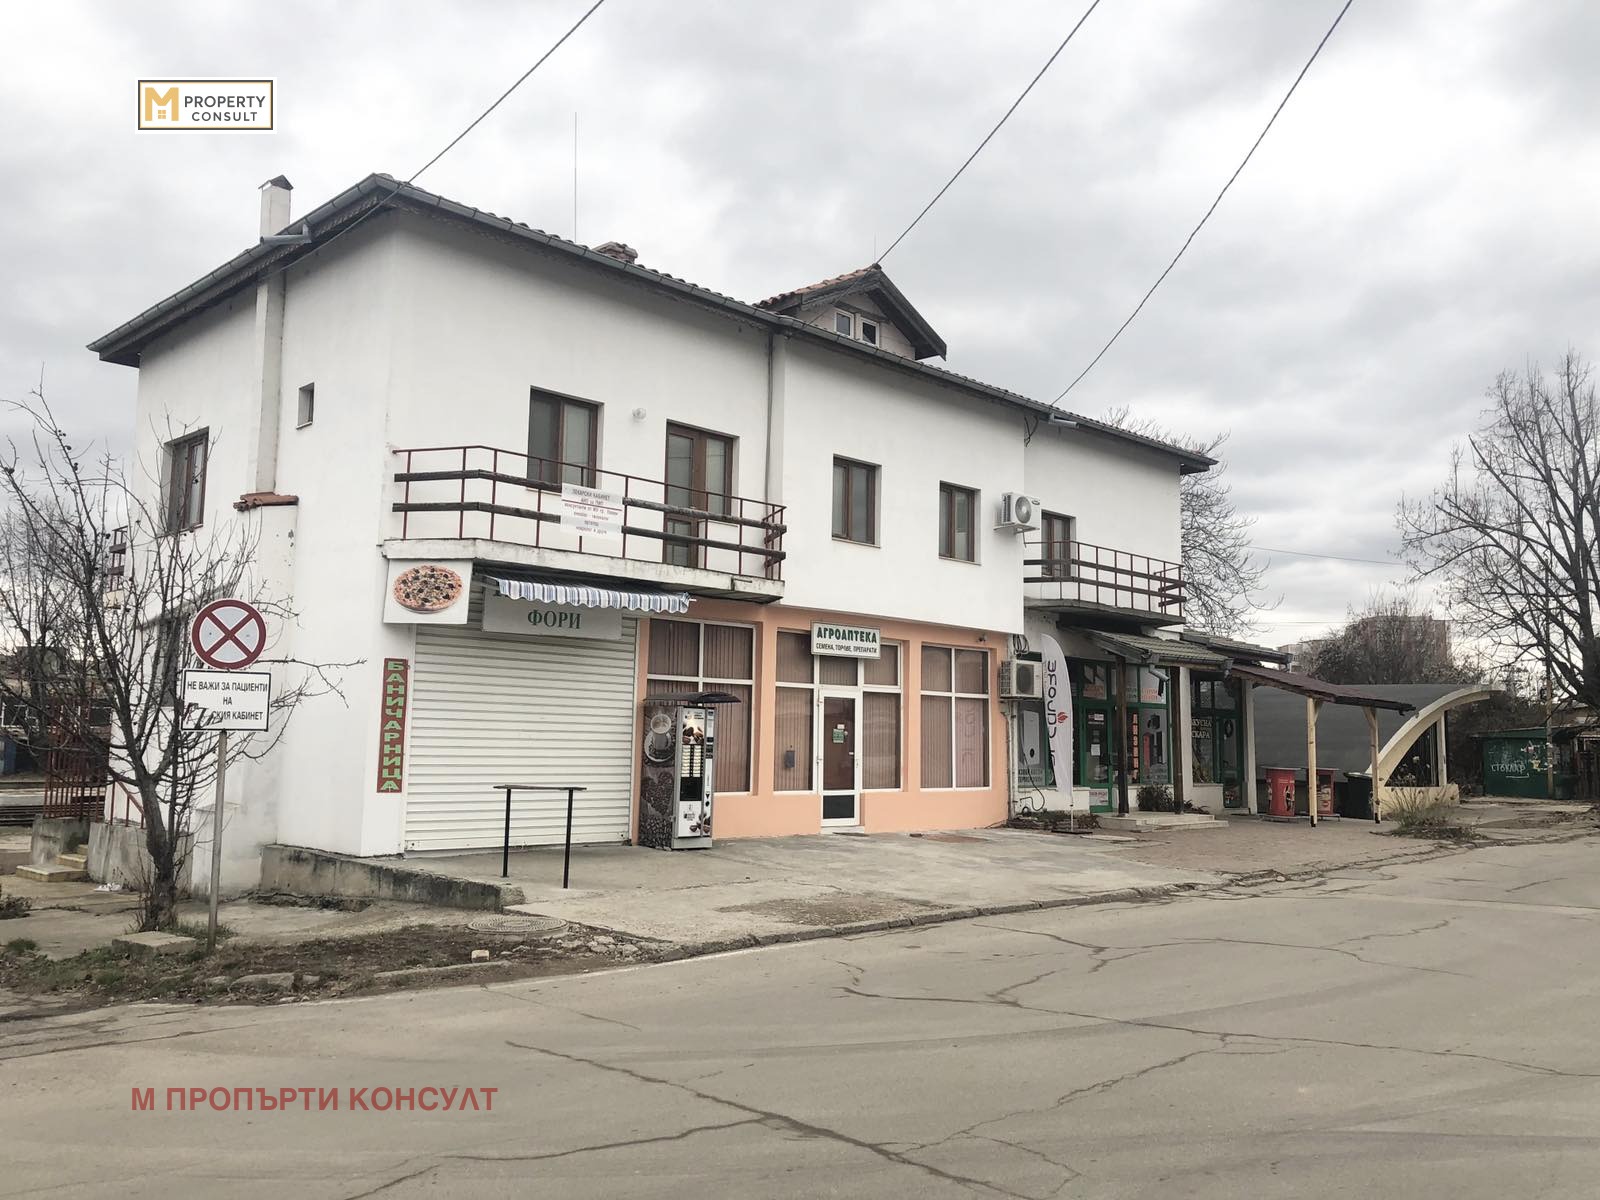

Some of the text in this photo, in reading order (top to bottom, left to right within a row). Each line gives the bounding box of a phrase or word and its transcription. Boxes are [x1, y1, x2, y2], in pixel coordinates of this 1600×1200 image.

[527, 609, 581, 629] ФОРИ
[816, 626, 877, 643] АГРОАПТЕКА
[187, 681, 268, 692] НЕ ВАЖИ ЗА ПАЦИЕНТИ
[223, 696, 233, 705] НА
[232, 711, 263, 720] КАБИНЕТ
[380, 660, 405, 791] БАНИЧАРНИЦА
